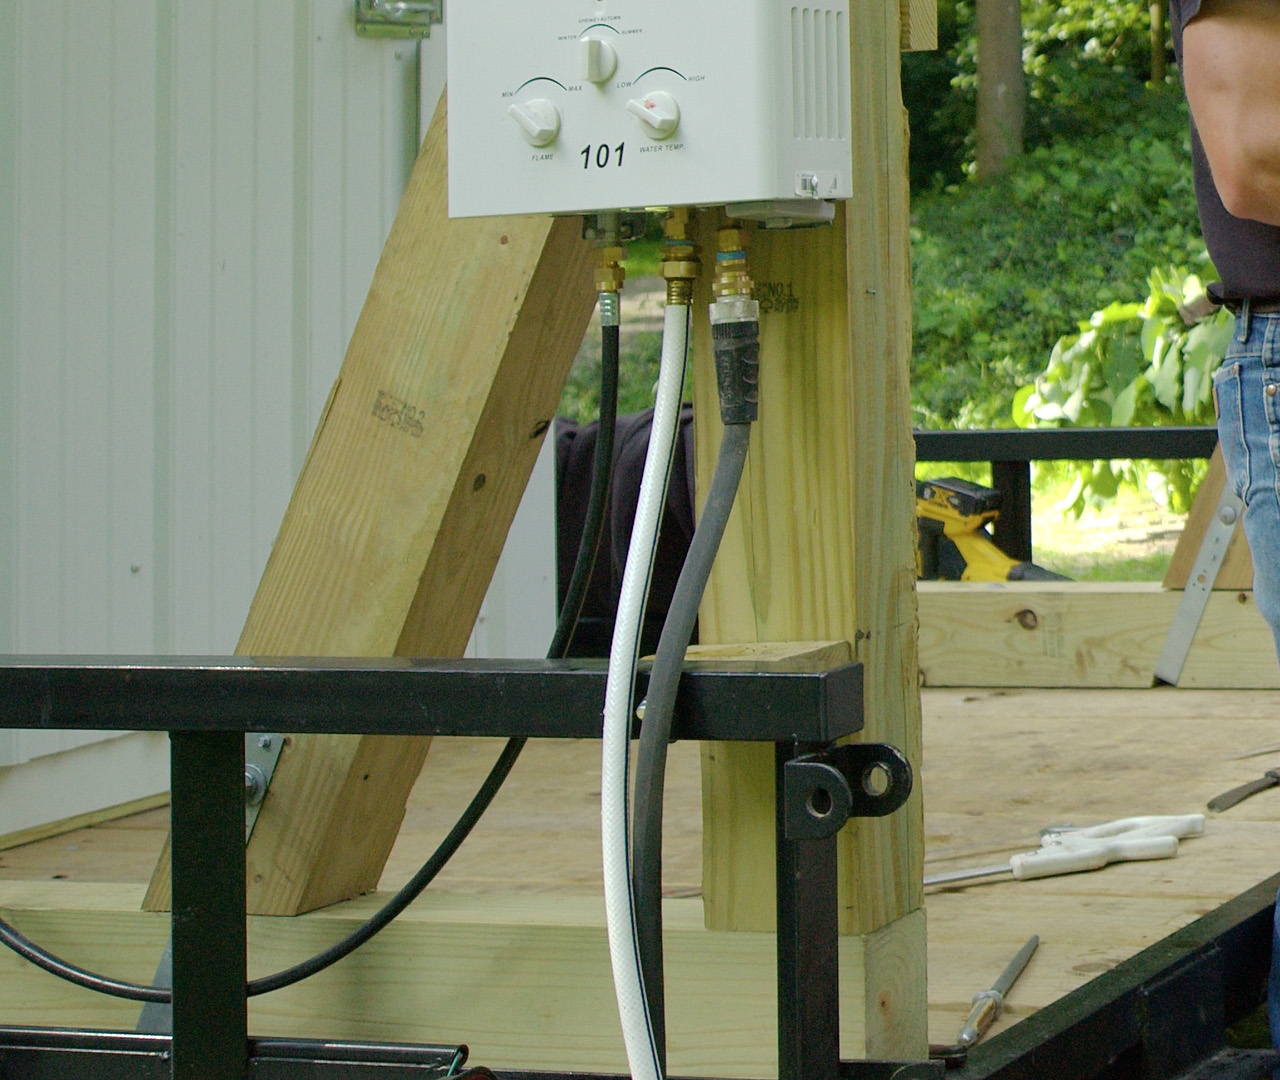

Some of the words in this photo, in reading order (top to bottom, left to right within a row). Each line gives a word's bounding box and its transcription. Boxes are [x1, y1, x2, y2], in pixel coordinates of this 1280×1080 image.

[616, 81, 632, 89] LOW
[639, 145, 663, 153] WATER
[531, 153, 555, 161] FLAME
[580, 142, 625, 169] 101
